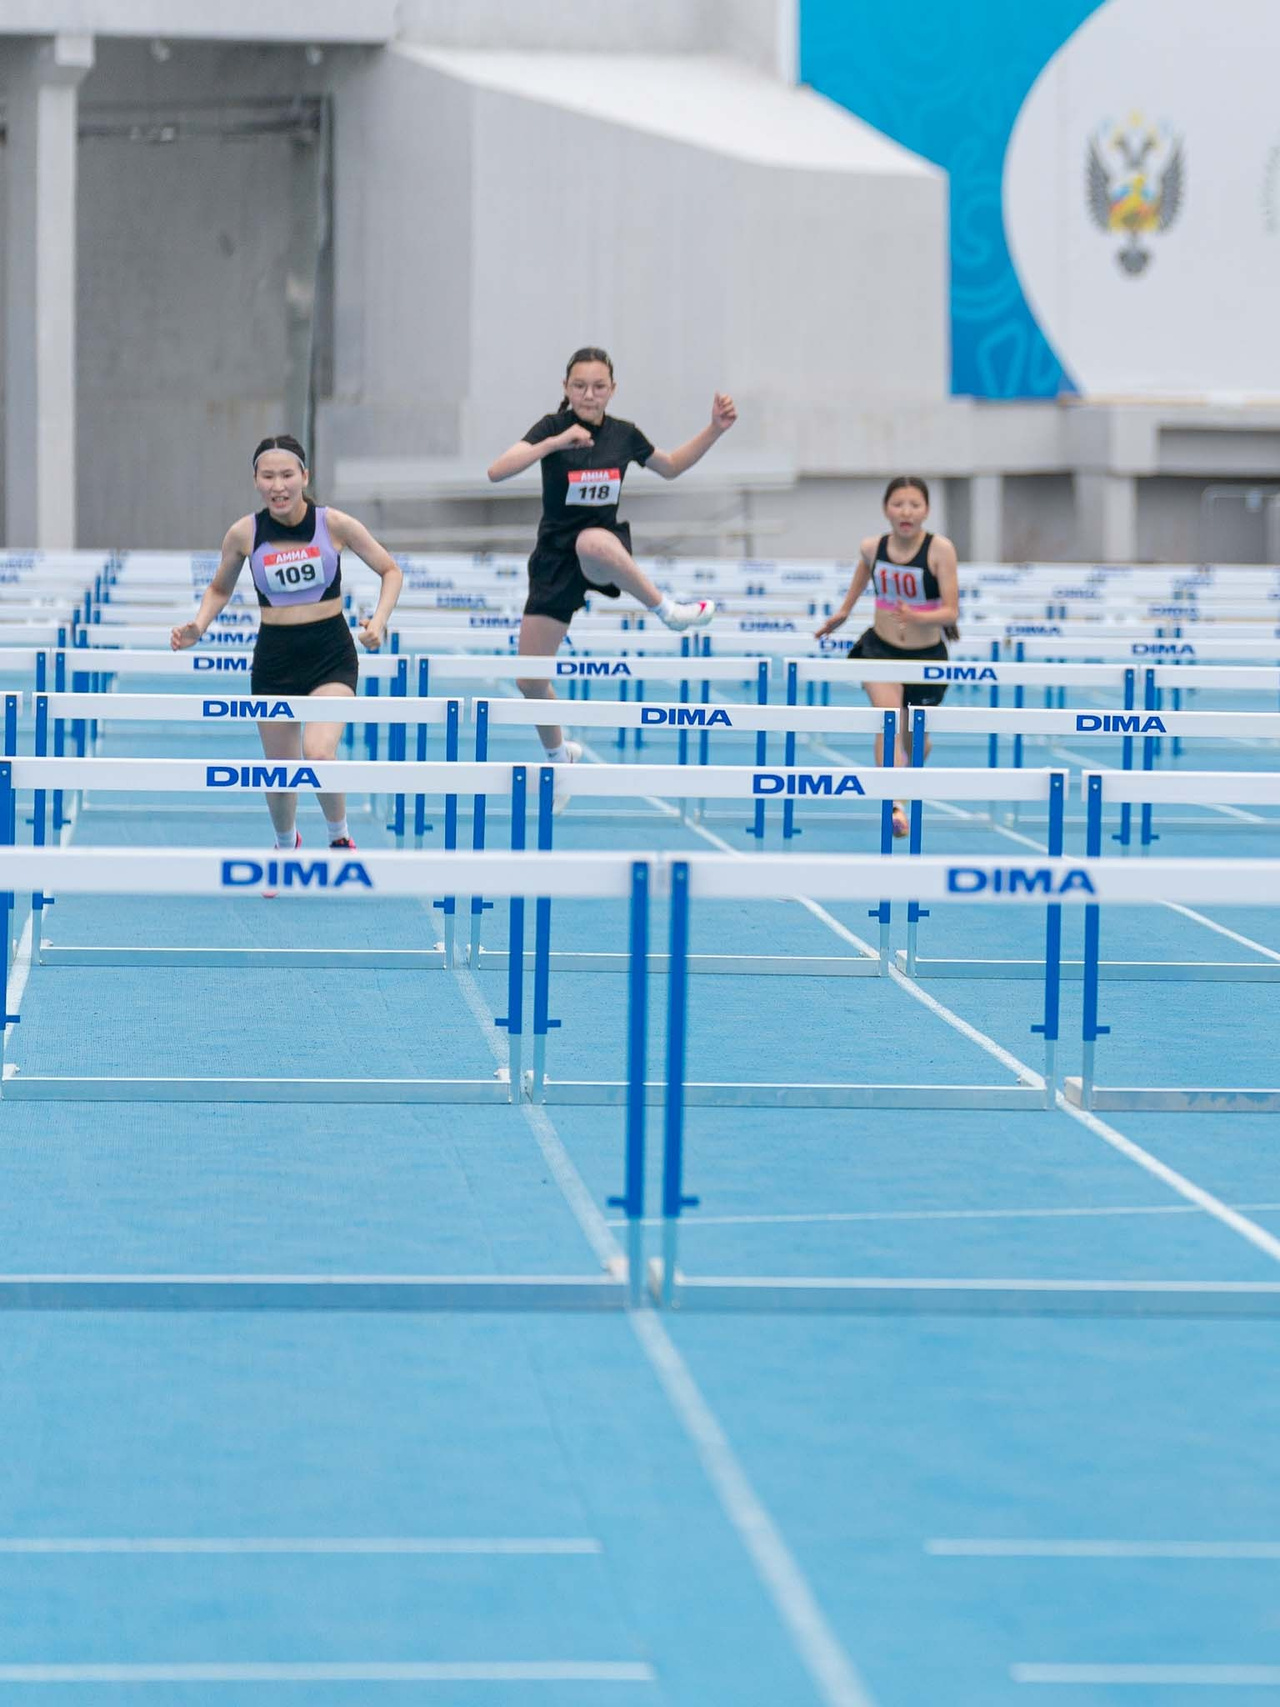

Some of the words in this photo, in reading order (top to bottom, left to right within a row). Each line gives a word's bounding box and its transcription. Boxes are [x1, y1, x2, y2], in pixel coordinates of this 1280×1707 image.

[579, 485, 610, 500] 118
[275, 564, 316, 587] 109
[880, 570, 916, 598] 110
[1132, 643, 1195, 655] DIMA
[194, 657, 253, 671] DIM
[556, 662, 632, 676] DIMA
[923, 666, 998, 681] DIMA
[203, 700, 295, 718] DIMA
[641, 708, 733, 726] DIMA
[1076, 715, 1167, 733] DIMA
[206, 766, 322, 788] DIMA
[753, 774, 865, 796] DIMA
[221, 860, 374, 888] DIMA
[947, 867, 1096, 895] DIMA
